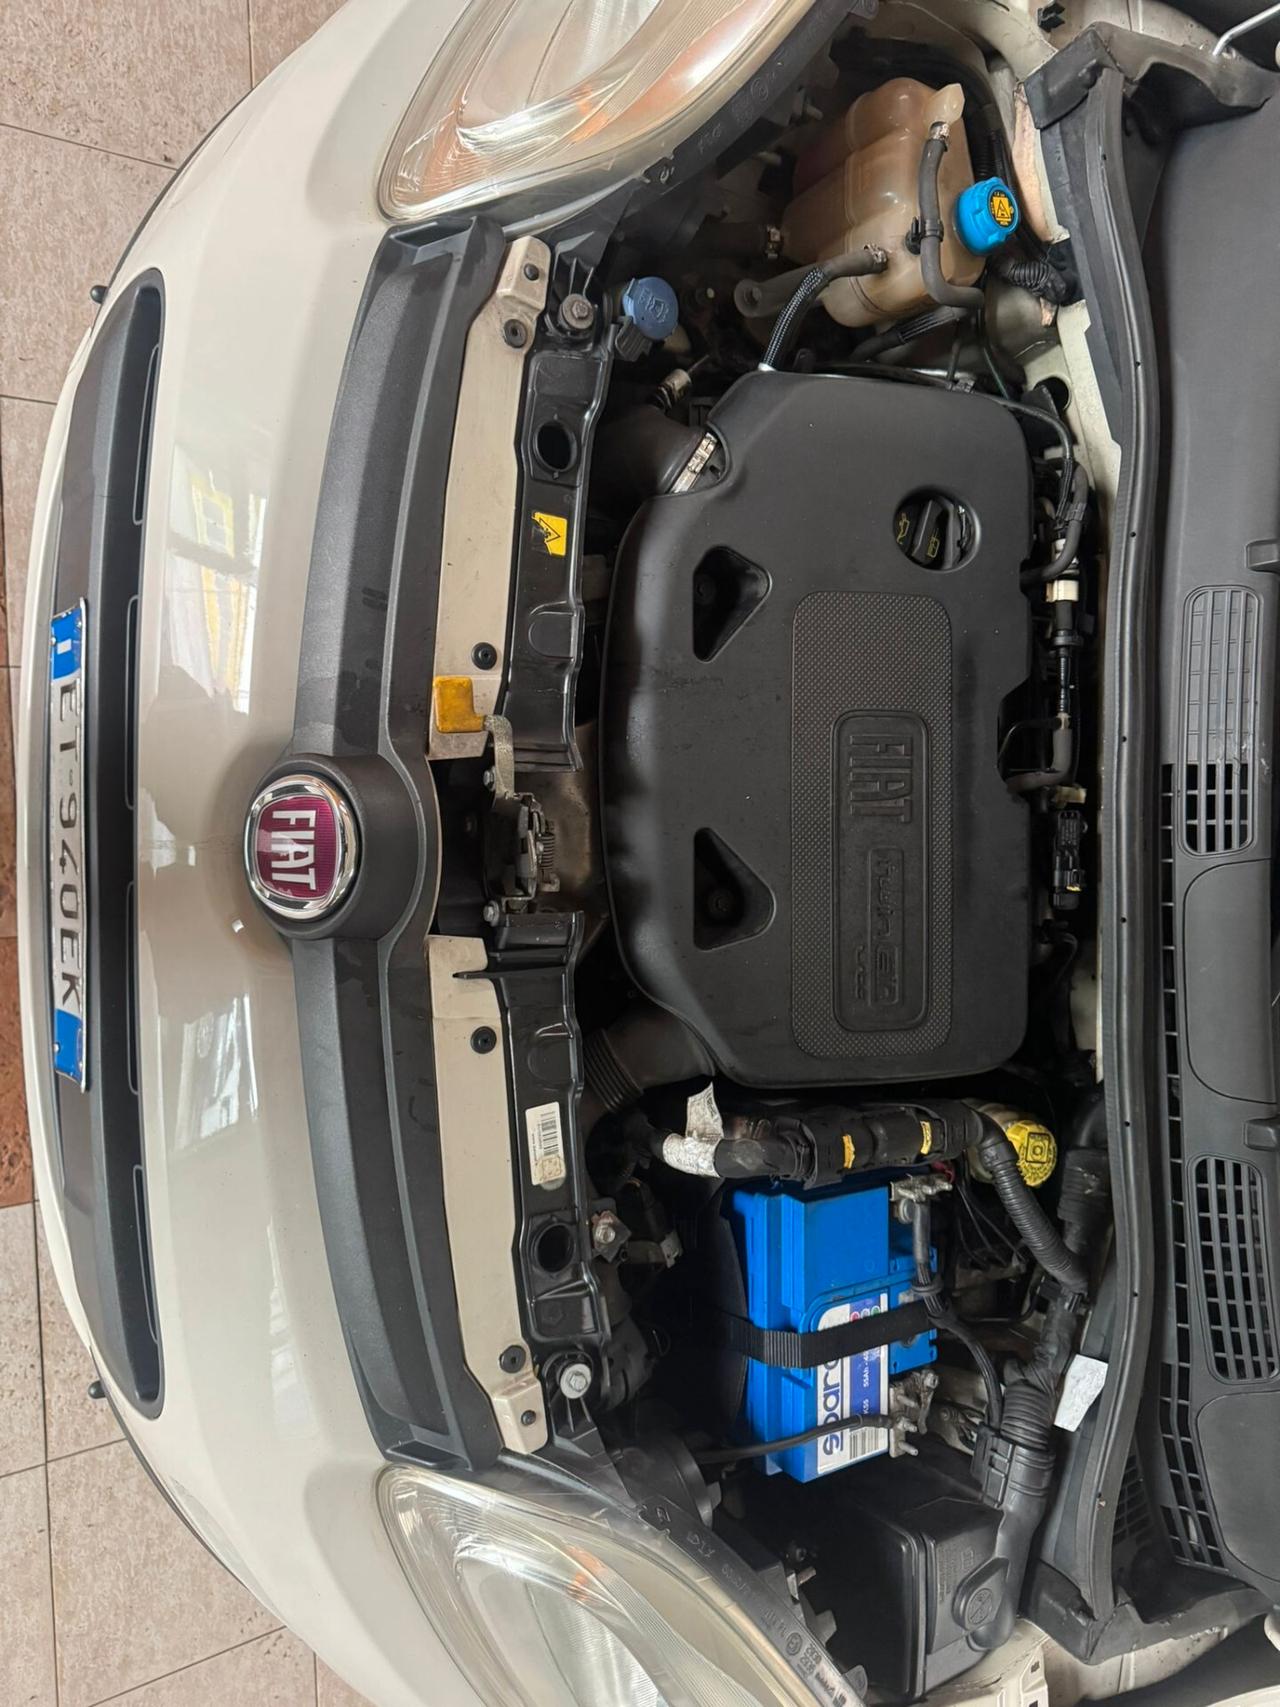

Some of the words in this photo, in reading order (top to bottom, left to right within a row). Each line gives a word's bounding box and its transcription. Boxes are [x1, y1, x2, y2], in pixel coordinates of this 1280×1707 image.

[59, 677, 81, 763] ET
[849, 734, 912, 824] FIAT
[271, 809, 317, 891] FIAT
[58, 790, 82, 1014] 940EK
[823, 1360, 841, 1456] sparc
